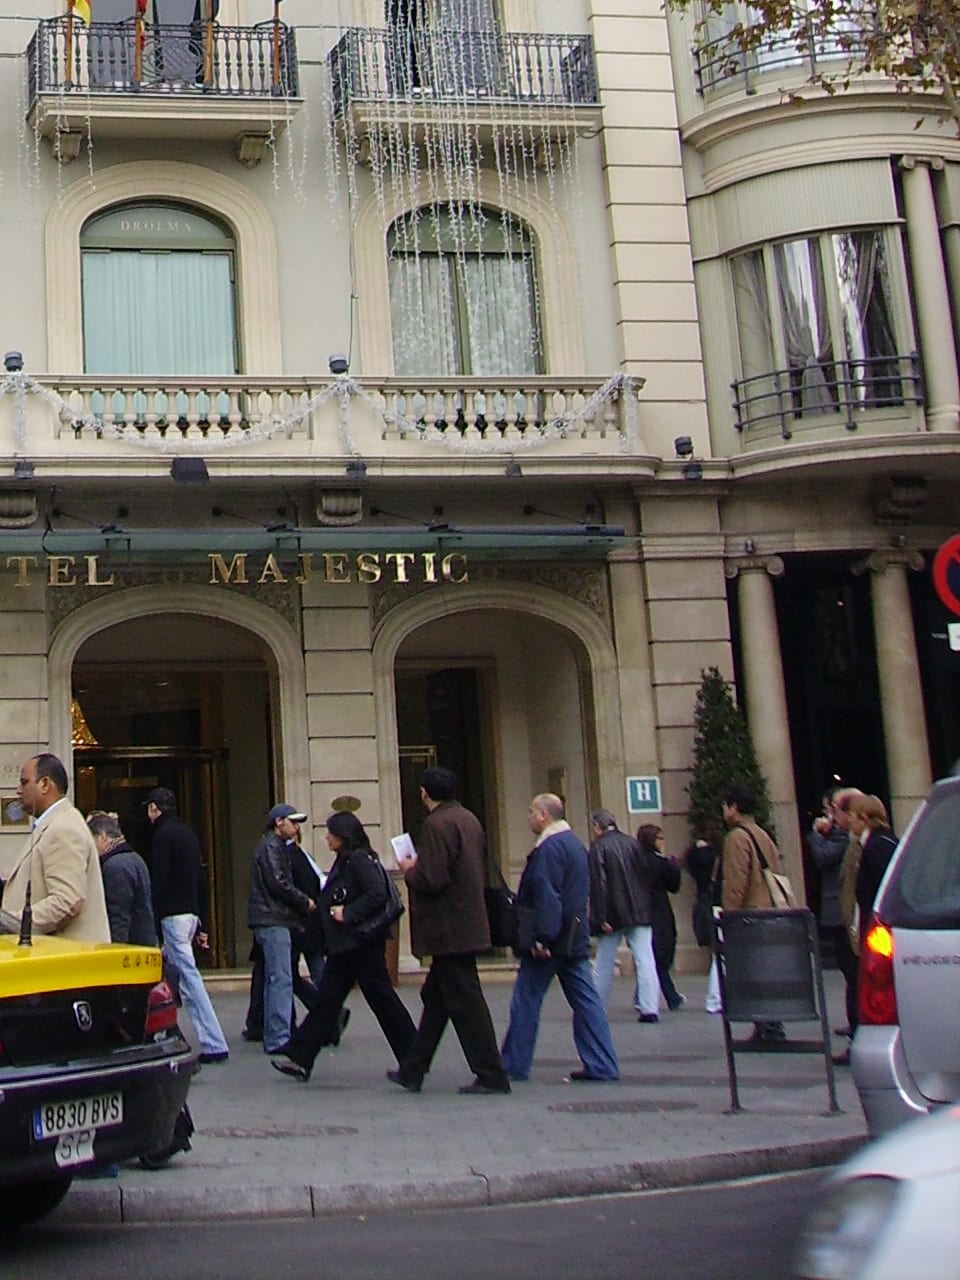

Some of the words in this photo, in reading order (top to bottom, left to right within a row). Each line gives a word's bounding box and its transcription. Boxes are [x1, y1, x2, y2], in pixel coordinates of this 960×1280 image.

[121, 220, 192, 232] DROLMA
[208, 553, 469, 584] MAJESTIC
[636, 781, 651, 801] H
[903, 955, 960, 966] PEUGEO
[45, 1101, 87, 1133] 8830
[91, 1095, 120, 1125] BVS
[60, 1131, 90, 1160] SP
